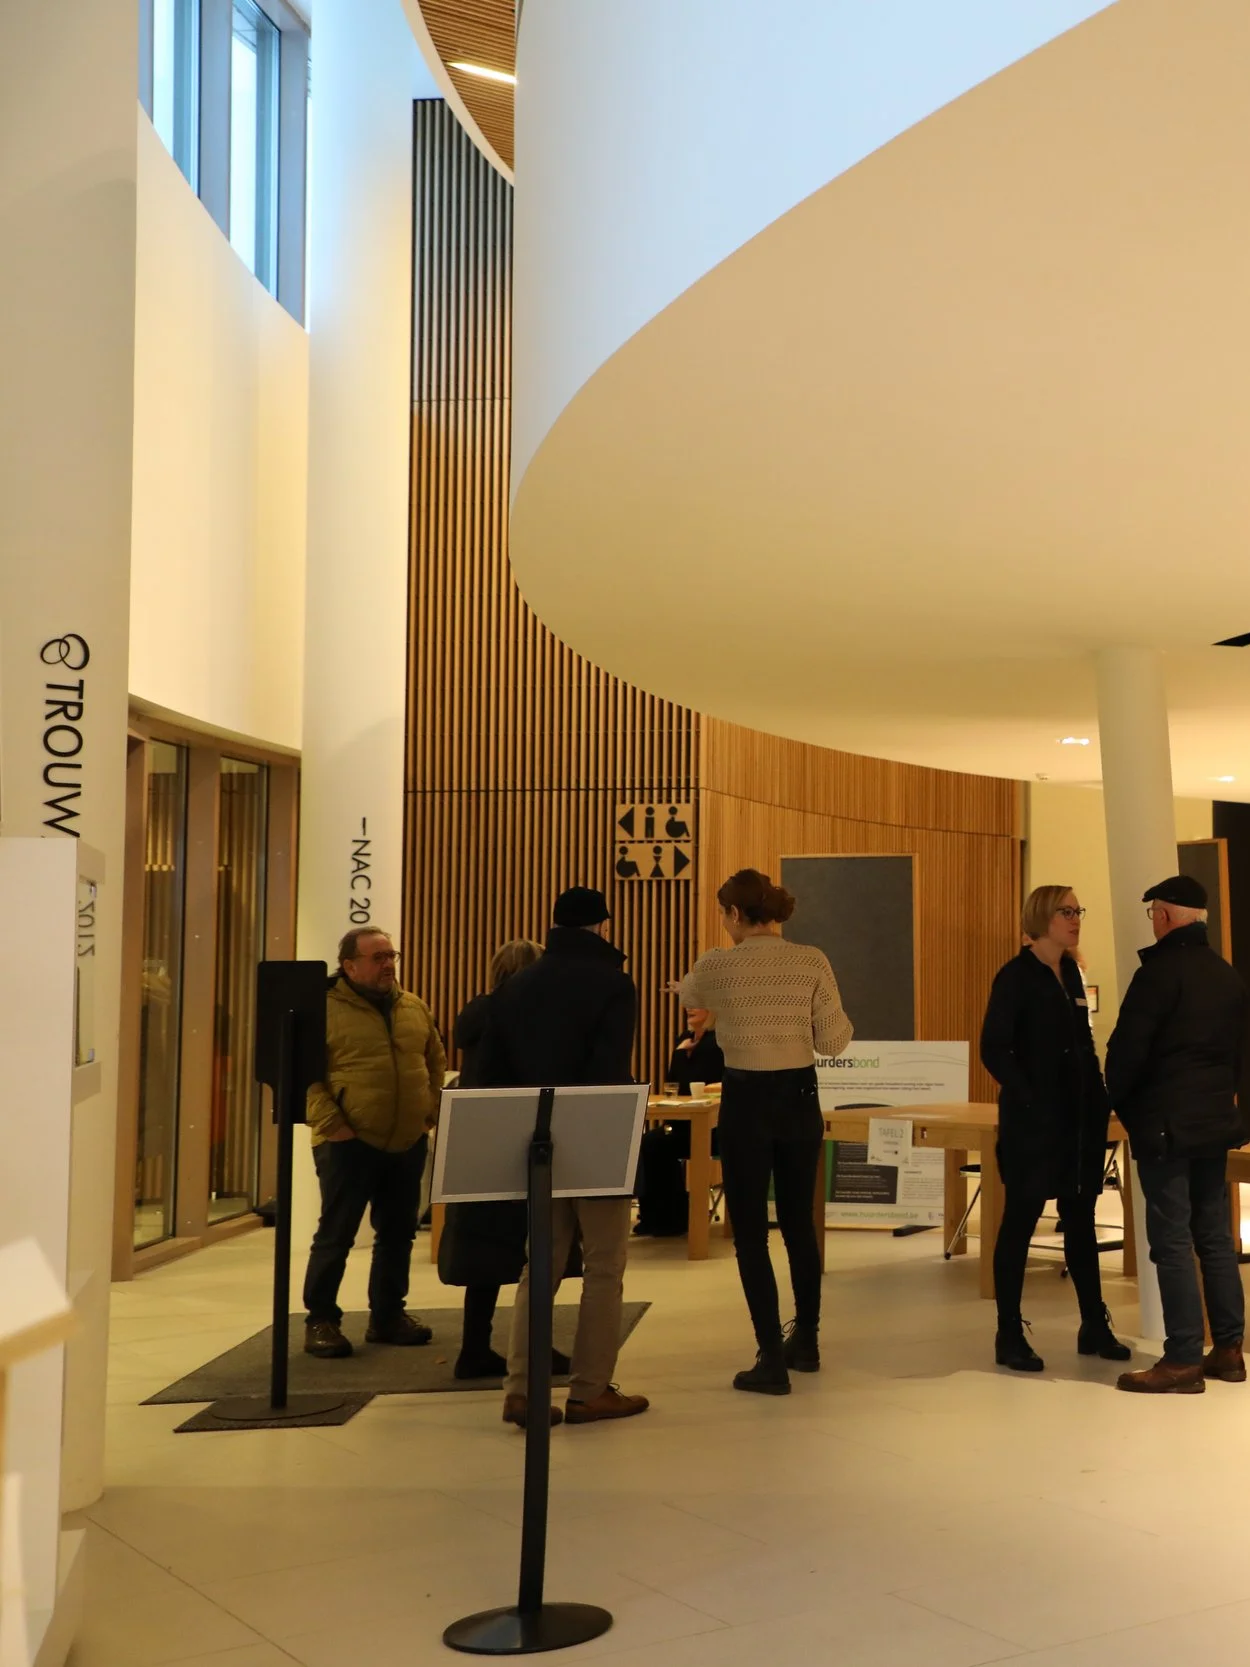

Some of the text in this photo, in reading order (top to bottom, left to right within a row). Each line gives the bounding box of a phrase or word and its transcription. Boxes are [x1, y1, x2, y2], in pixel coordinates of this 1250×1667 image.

[42, 679, 84, 838] TROUW
[349, 897, 371, 925] 20
[815, 1055, 880, 1069] urdersbond
